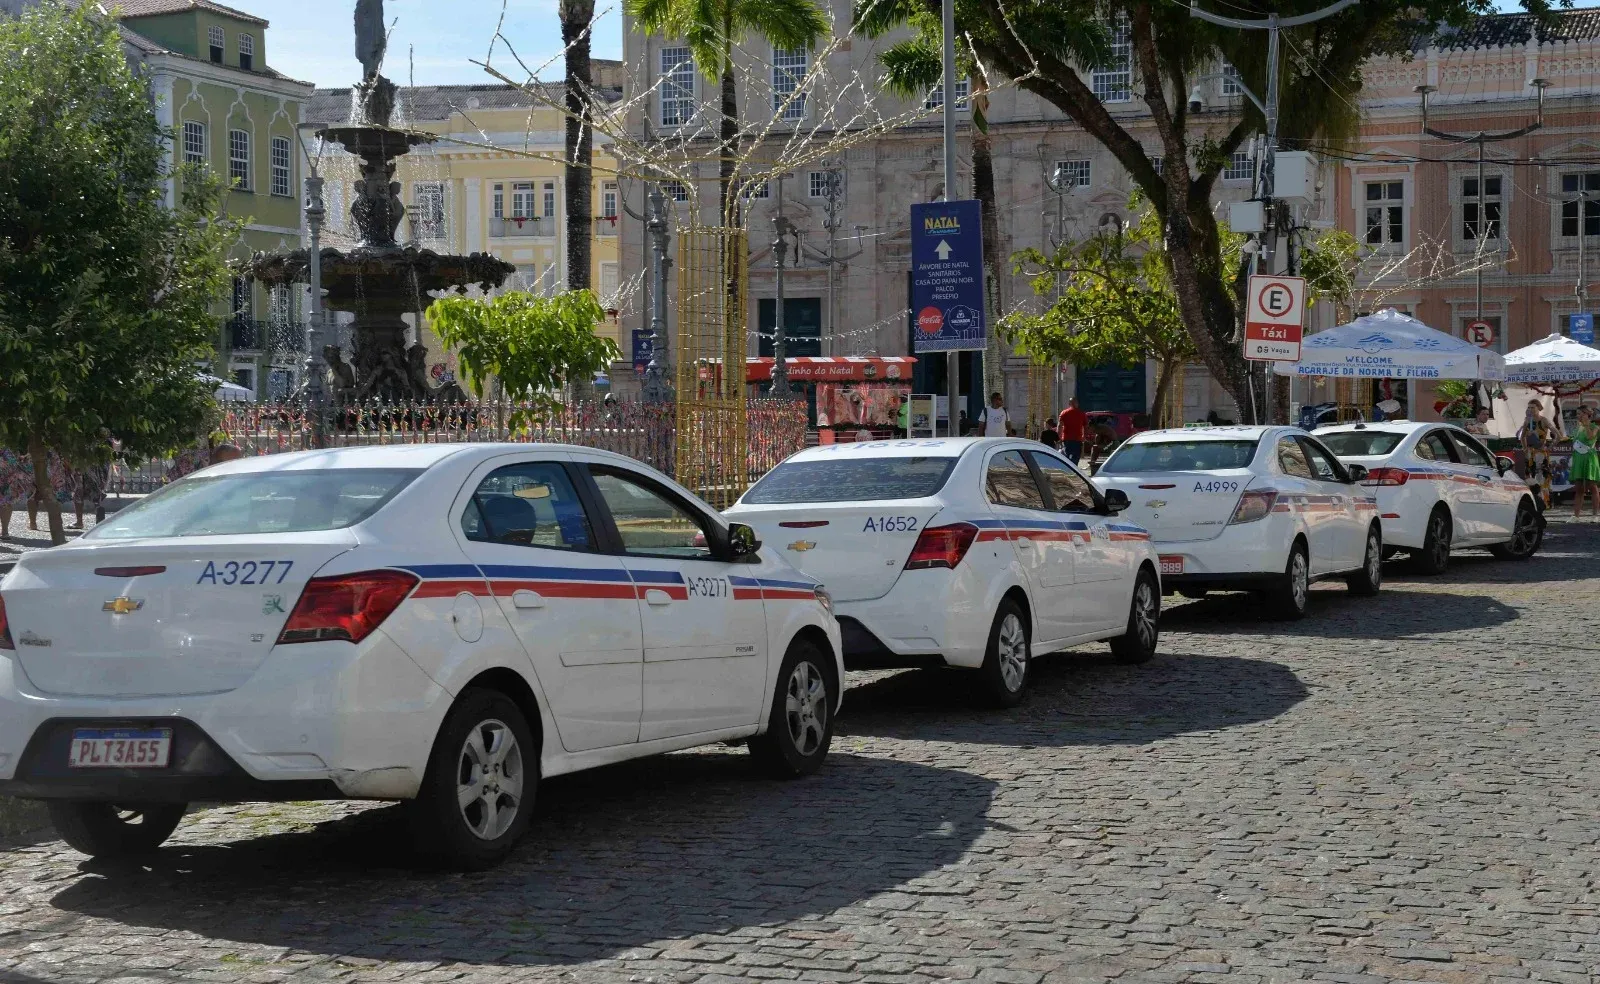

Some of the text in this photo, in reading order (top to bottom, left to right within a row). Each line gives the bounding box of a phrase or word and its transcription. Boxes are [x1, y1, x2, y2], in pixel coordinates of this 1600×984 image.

[925, 216, 960, 229] NATAL
[919, 262, 942, 270] ÁRVORE
[951, 261, 970, 269] NATAL
[928, 270, 961, 278] SANITÁRIOS
[1269, 290, 1283, 310] E
[1261, 327, 1287, 339] Táxi
[1346, 356, 1393, 364] WELCOME
[815, 366, 826, 375] do
[829, 365, 854, 375] Natal
[1343, 368, 1354, 376] DA
[1359, 368, 1393, 377] NORMA
[1397, 369, 1402, 377] E
[1407, 369, 1439, 378] FILHAS
[1193, 481, 1238, 493] A-4999
[863, 516, 918, 532] A-1652
[196, 560, 294, 586] A-3277
[688, 576, 727, 598] A-3277
[80, 740, 160, 763] PLT3A55
